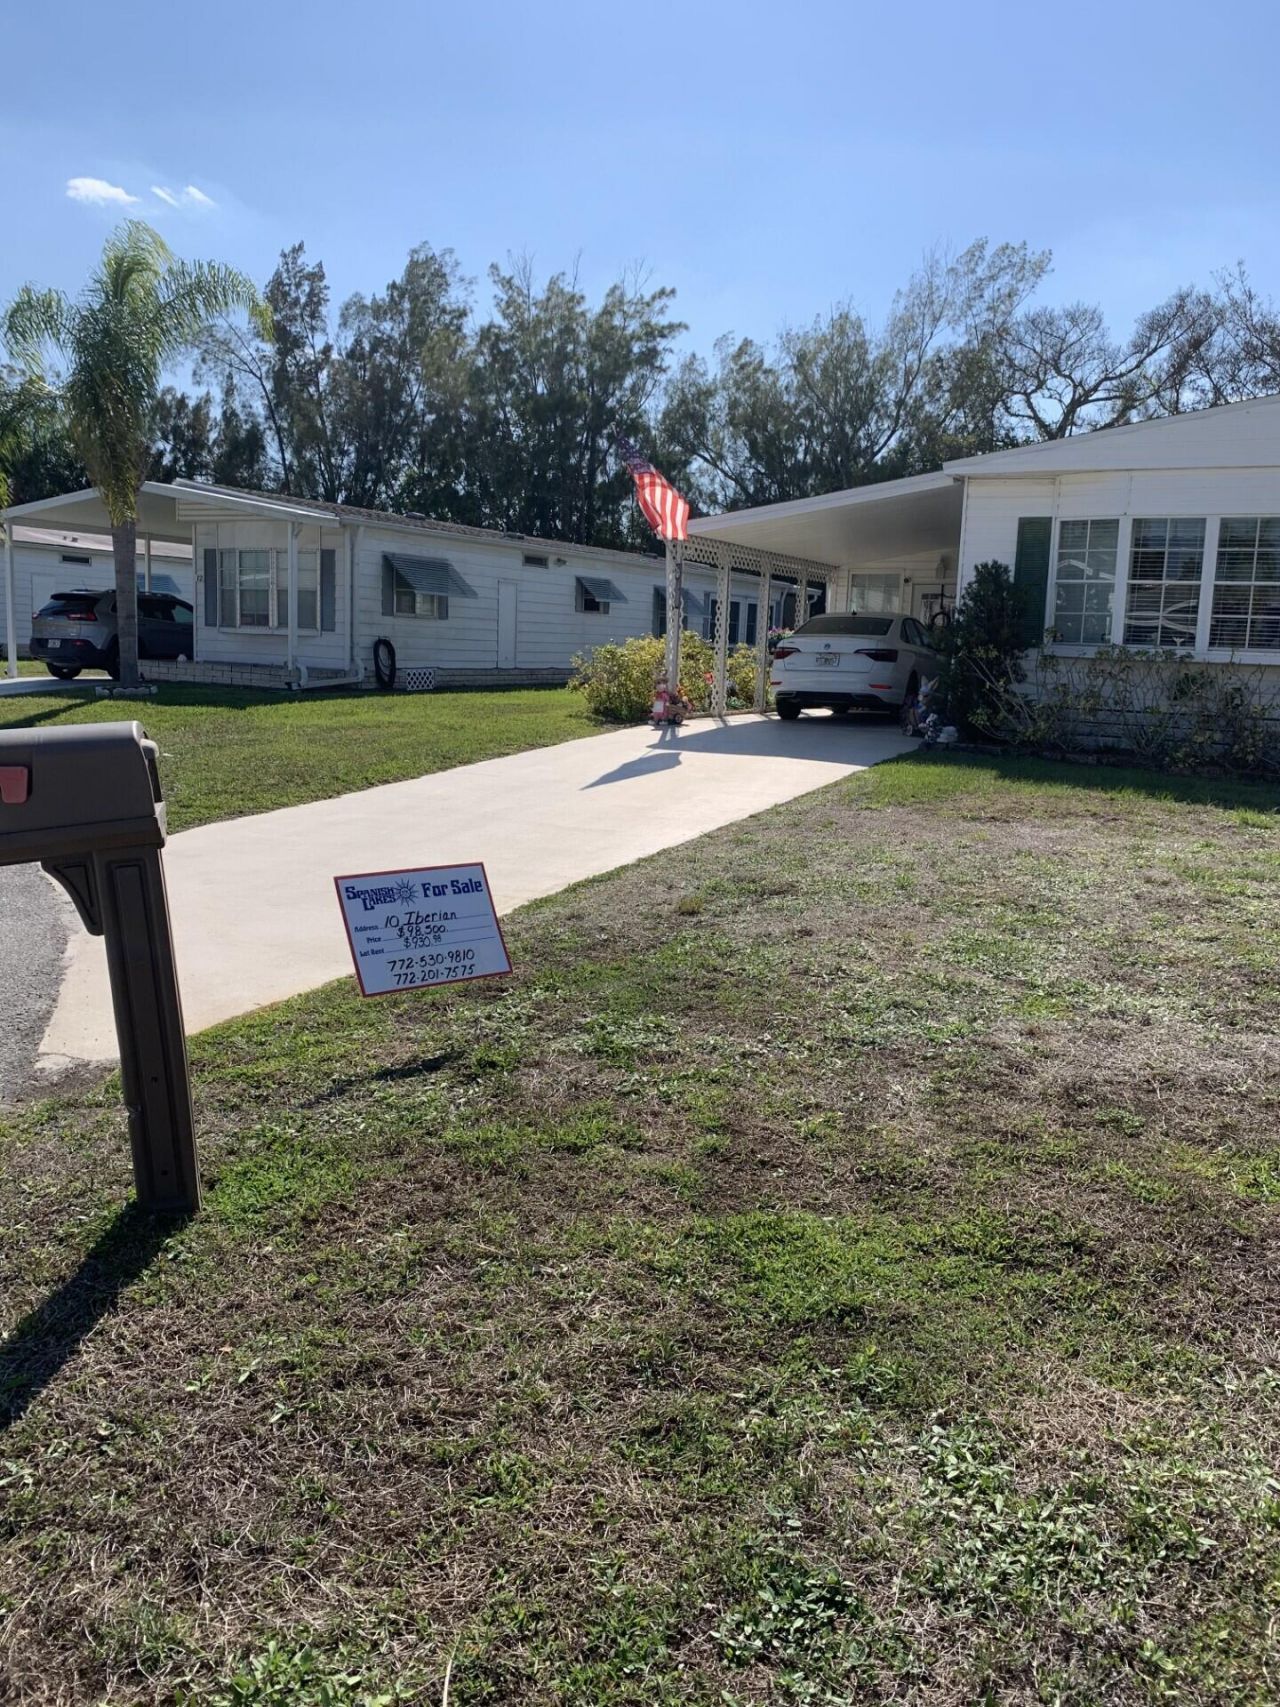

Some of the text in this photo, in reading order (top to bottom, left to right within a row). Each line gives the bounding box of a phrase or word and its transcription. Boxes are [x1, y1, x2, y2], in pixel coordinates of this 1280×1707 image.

[421, 878, 483, 898] For Sale
[384, 910, 457, 928] 10 Iberian
